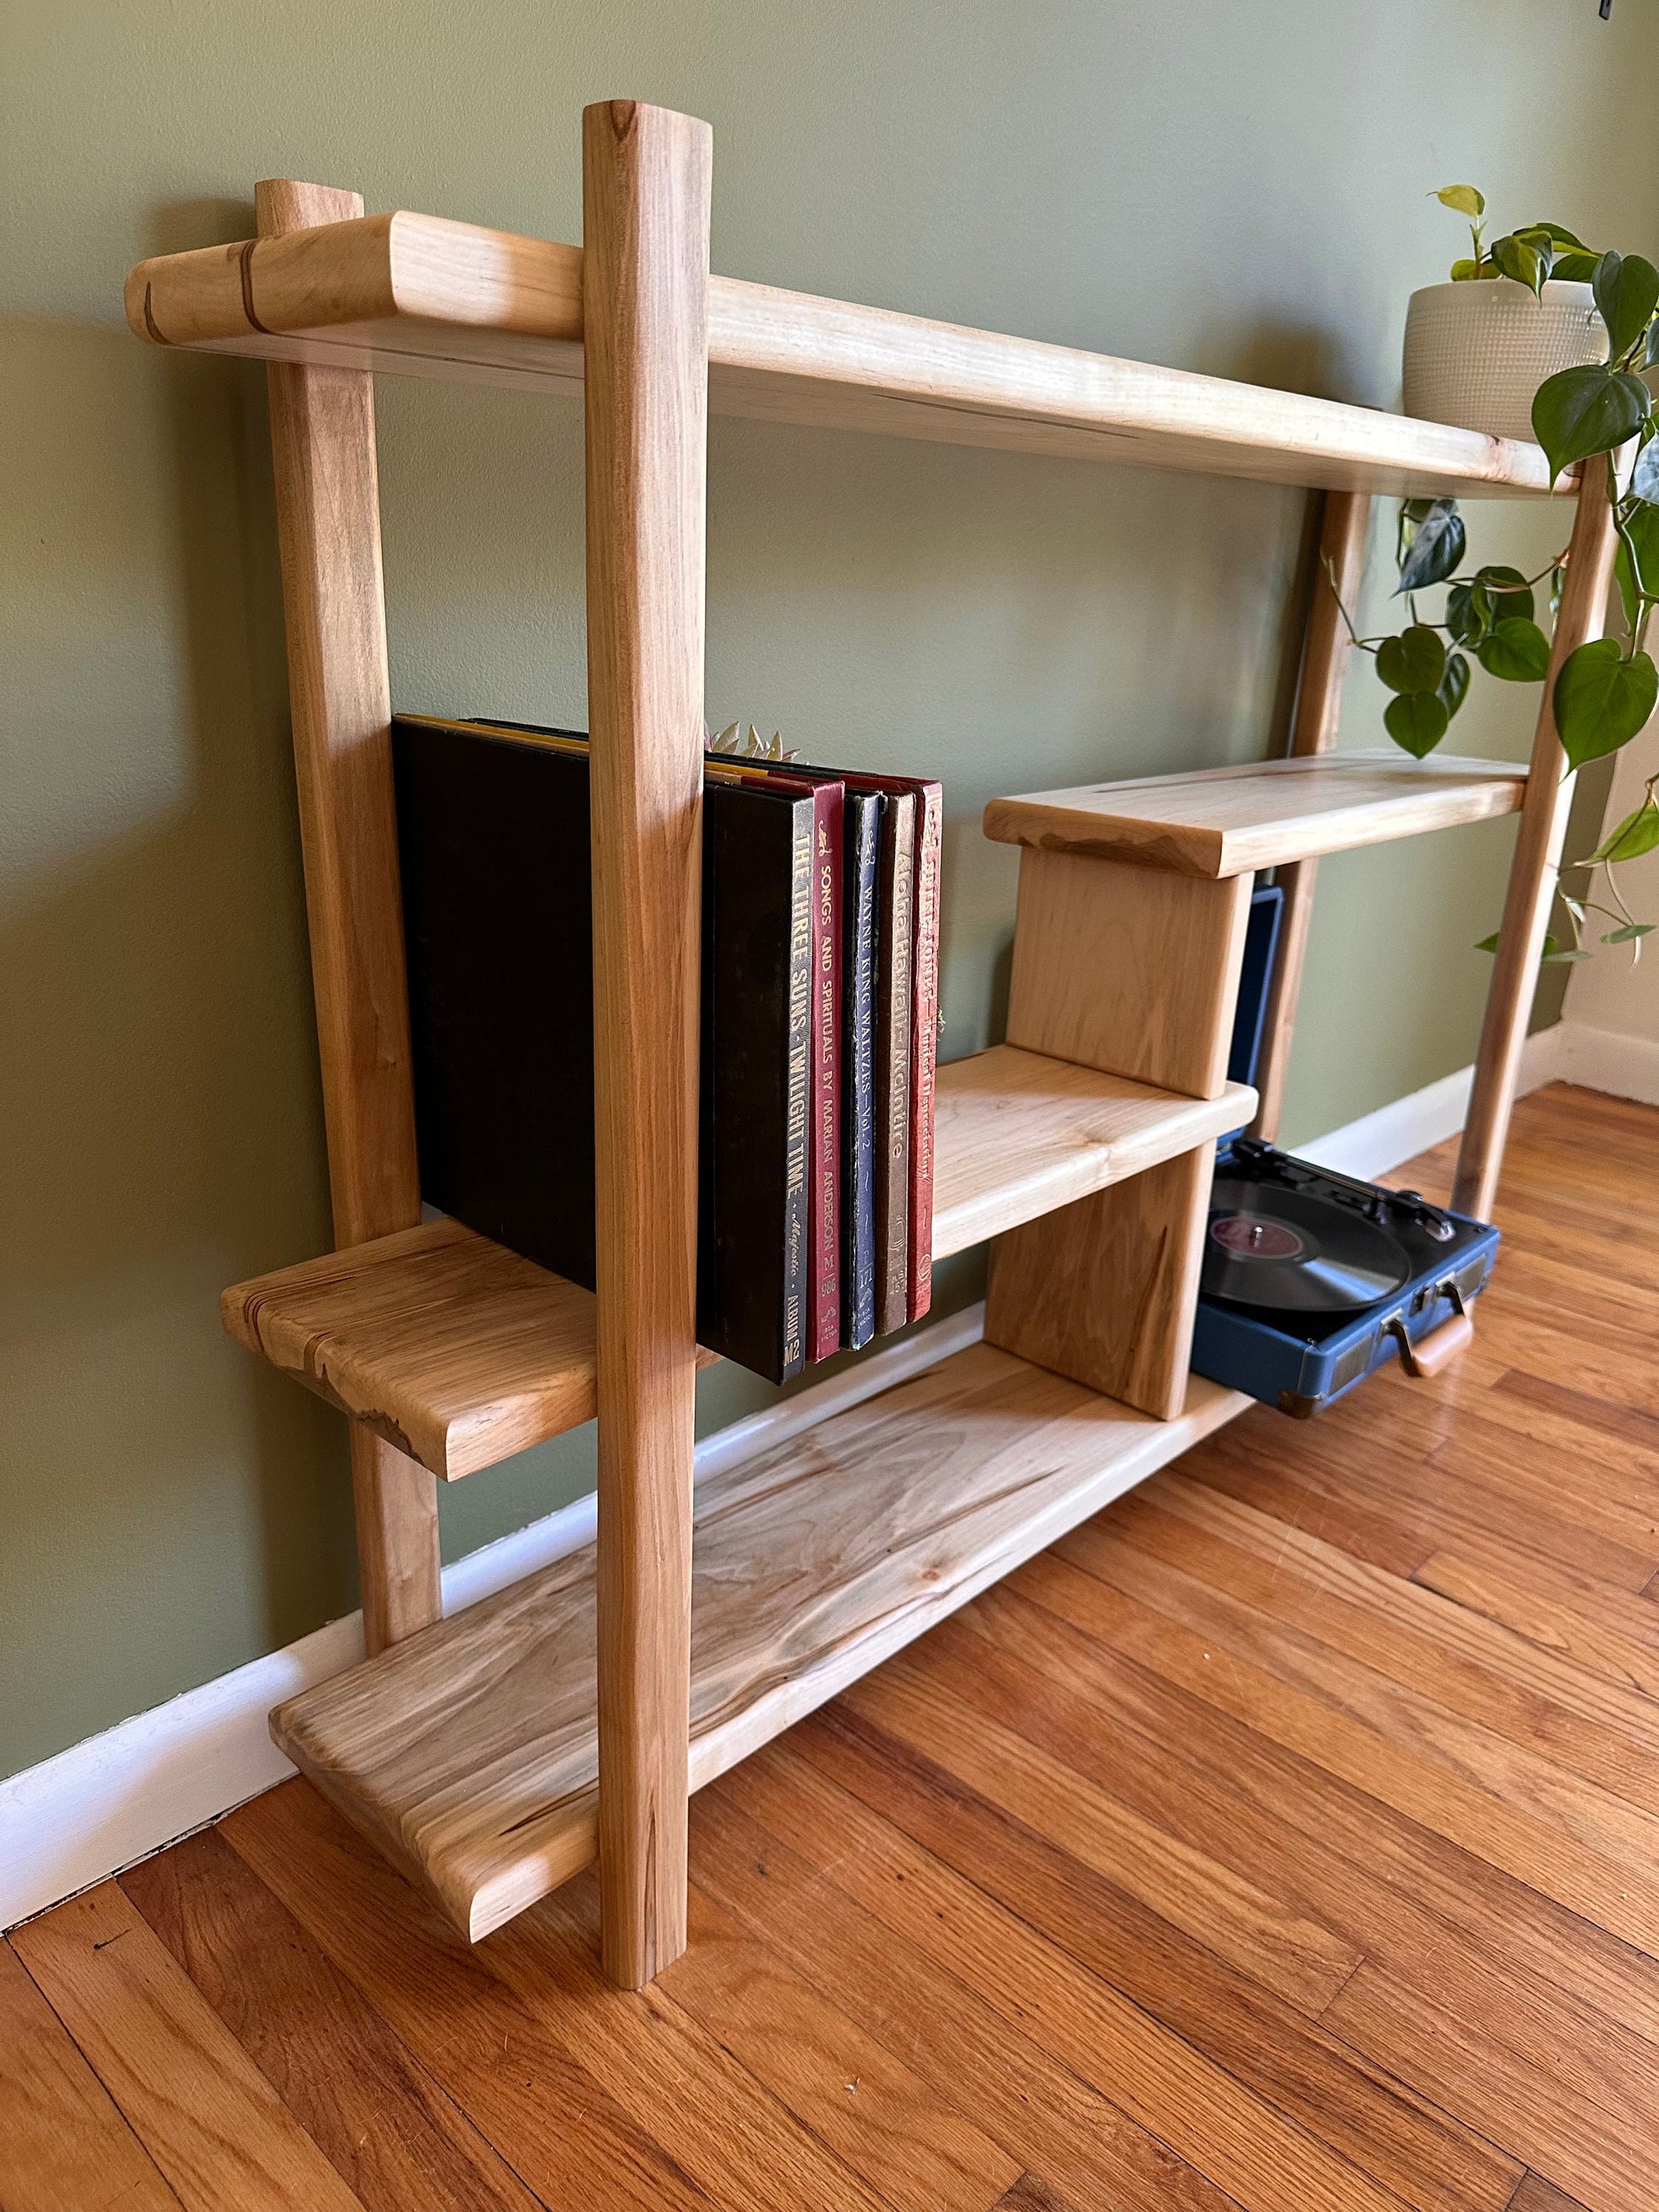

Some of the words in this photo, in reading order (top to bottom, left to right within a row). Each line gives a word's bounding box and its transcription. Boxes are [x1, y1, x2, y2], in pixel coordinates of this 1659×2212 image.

[795, 833, 810, 885] THE
[820, 865, 832, 926] SONGS
[862, 885, 873, 953] WAYNE
[895, 853, 910, 930] Aloha
[792, 886, 809, 962] THREE
[822, 935, 833, 972] AND
[790, 968, 807, 1031] SUNS
[861, 957, 872, 1004] KING
[893, 939, 909, 1025] Hawaii
[822, 981, 833, 1064] SPIRITUALS
[788, 1041, 806, 1142] TWILIGHT
[823, 1070, 833, 1089] BY
[892, 1048, 907, 1159] McIntire
[823, 1100, 833, 1164] MARIAN
[862, 1139, 870, 1150] 2
[787, 1143, 804, 1200] TIME
[824, 1171, 835, 1251] ANDERSON
[787, 1213, 802, 1278] Majestic
[824, 1254, 834, 1272] M
[786, 1295, 799, 1342] ALBUM
[822, 1278, 836, 1297] 986
[783, 1338, 800, 1367] M2
